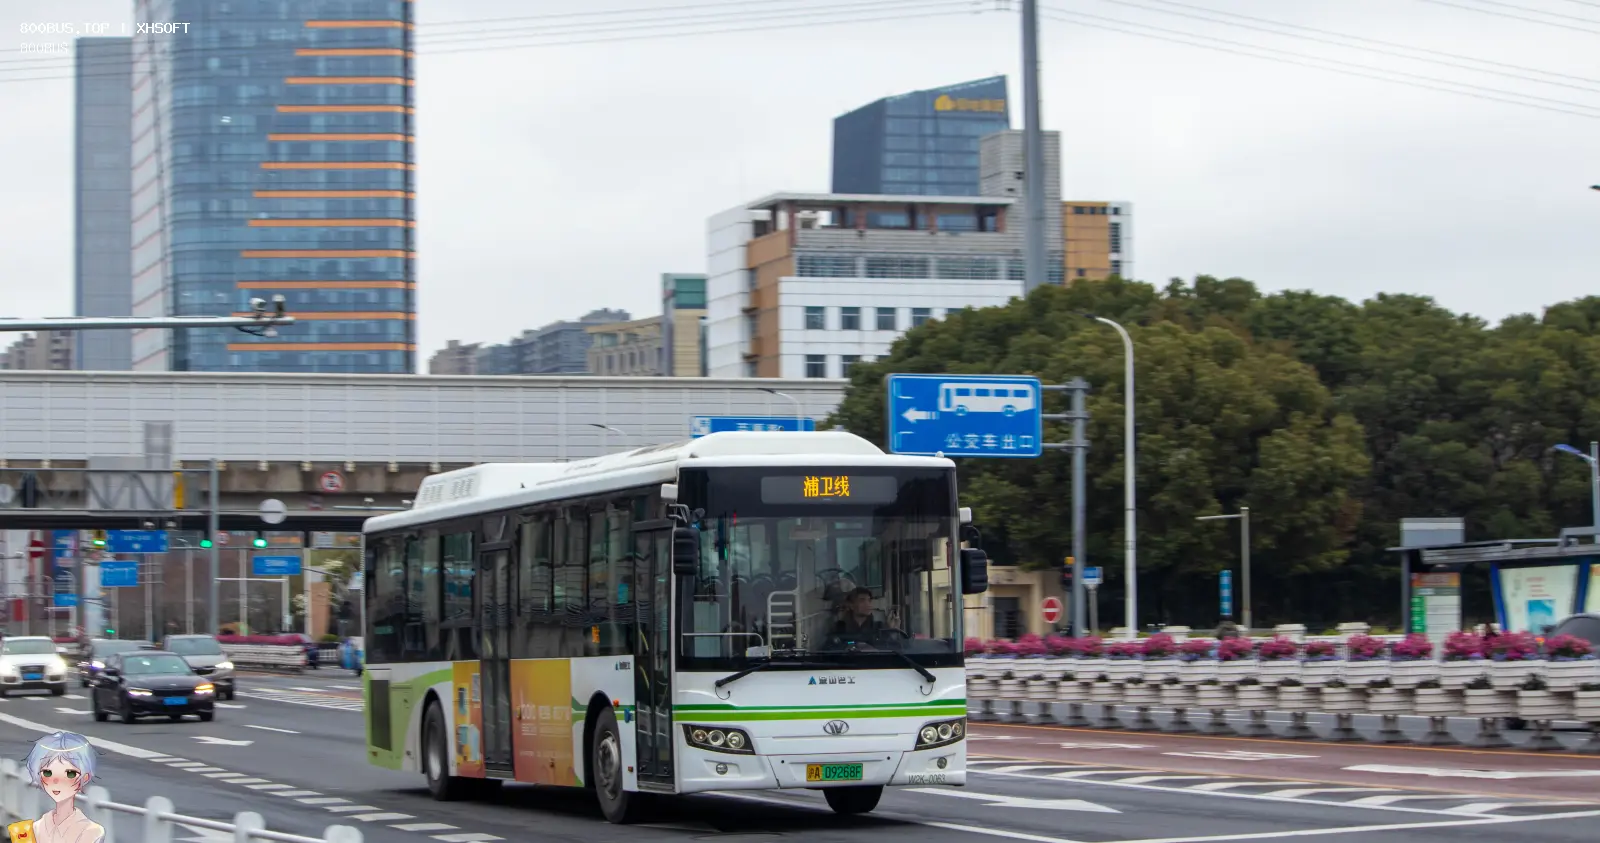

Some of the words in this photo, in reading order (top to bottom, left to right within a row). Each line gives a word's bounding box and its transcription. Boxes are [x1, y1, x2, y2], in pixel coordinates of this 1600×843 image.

[944, 432, 1034, 450] 公交车出口
[803, 475, 850, 497] 浦卫线
